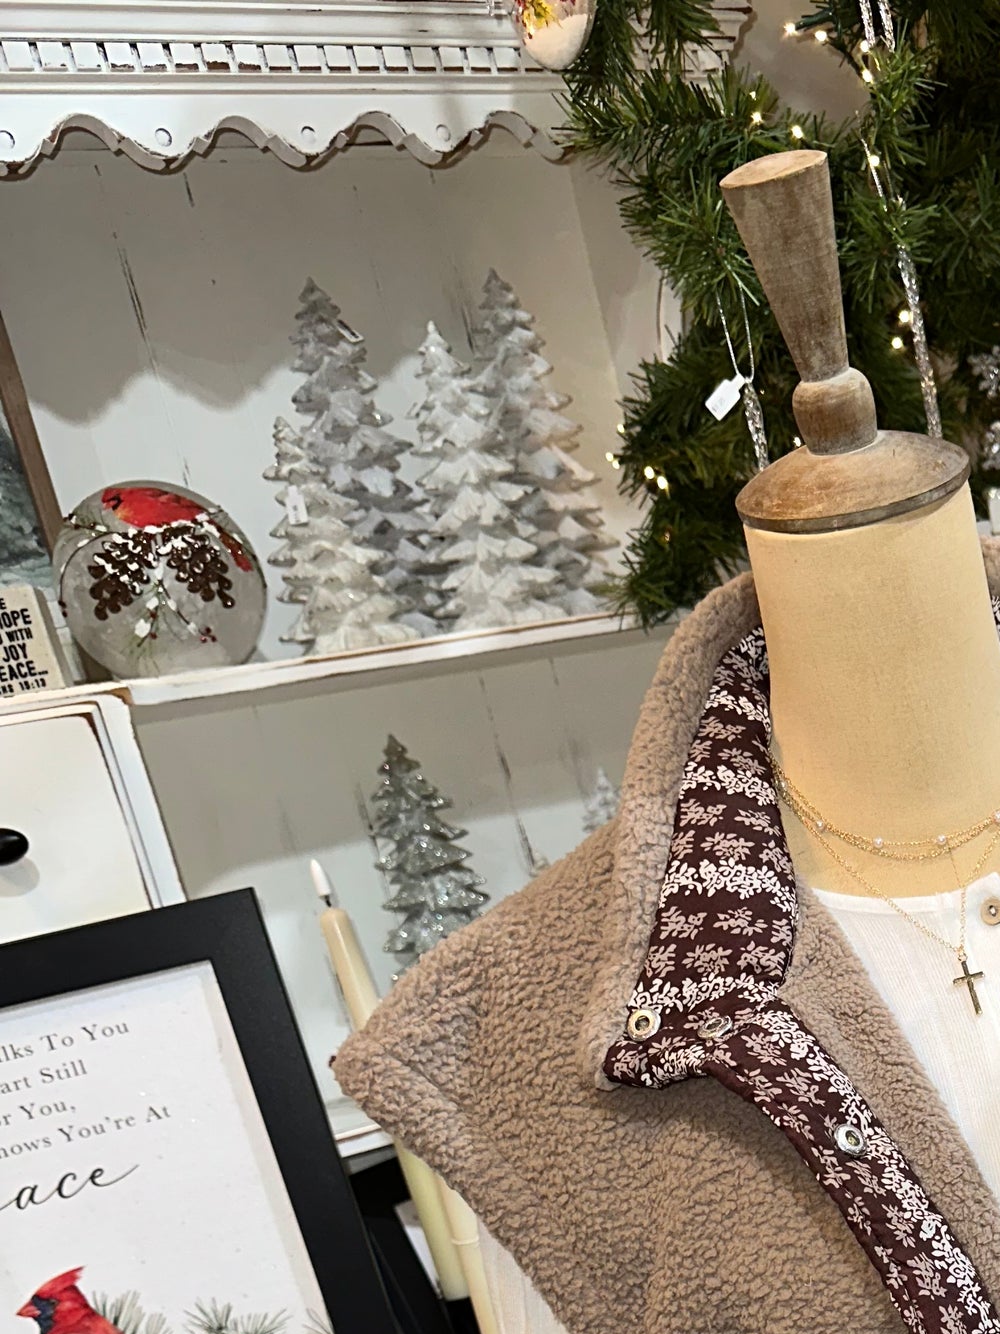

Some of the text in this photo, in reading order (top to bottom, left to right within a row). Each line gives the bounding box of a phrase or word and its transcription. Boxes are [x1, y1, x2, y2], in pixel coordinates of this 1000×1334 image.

[5, 627, 33, 642] WITH
[3, 642, 28, 662] JOY
[0, 1021, 130, 1062] lks To You
[40, 1060, 88, 1084] Still
[19, 1101, 76, 1120] You,
[58, 1115, 136, 1143] You're
[145, 1104, 171, 1123] At
